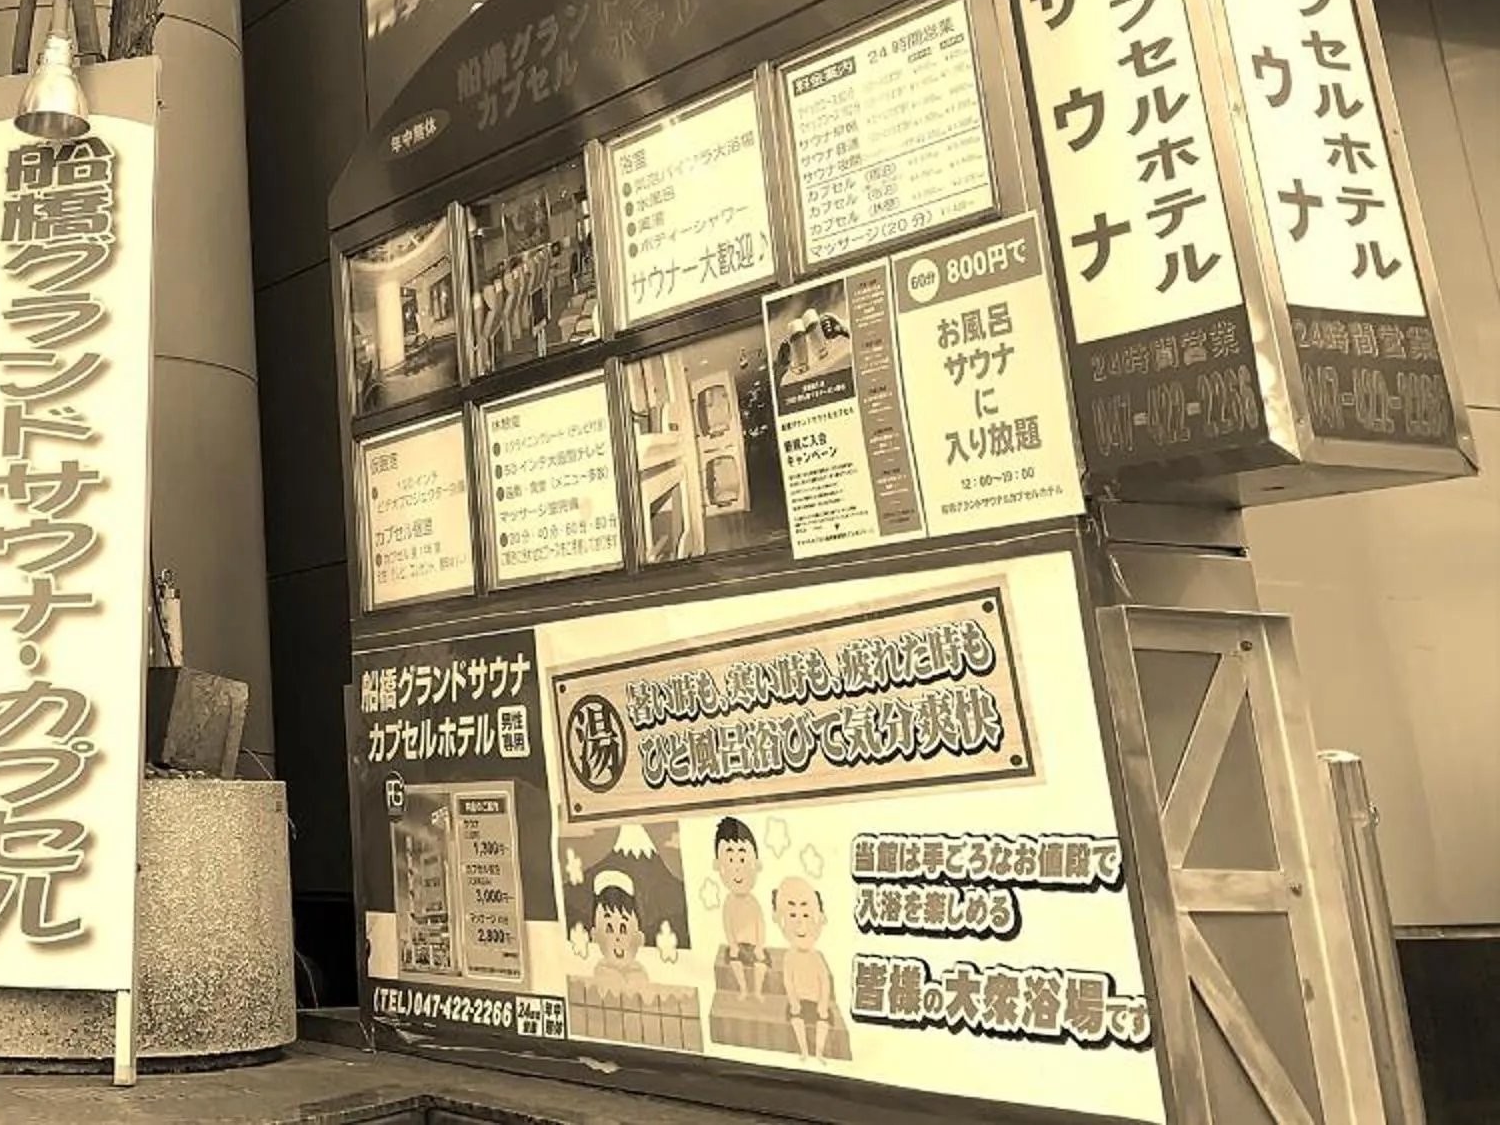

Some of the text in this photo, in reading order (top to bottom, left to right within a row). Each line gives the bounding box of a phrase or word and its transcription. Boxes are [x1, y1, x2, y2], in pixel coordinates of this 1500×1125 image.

[389, 117, 438, 155] 年中無休
[946, 239, 1029, 285] 800円で
[936, 301, 1014, 350] お風呂
[944, 342, 1016, 386] サウナ
[973, 387, 1000, 420] に
[944, 415, 1044, 466] 入り放題
[360, 652, 531, 714] 船橋グランドサウナ
[367, 712, 496, 763] カプセルホテル
[574, 701, 622, 787] 湯
[638, 685, 1006, 789] ひと風呂浴びて気分爽快
[851, 835, 1122, 889] 当館は手ごろなお値段で
[853, 884, 1021, 939] 入浴を楽しめる
